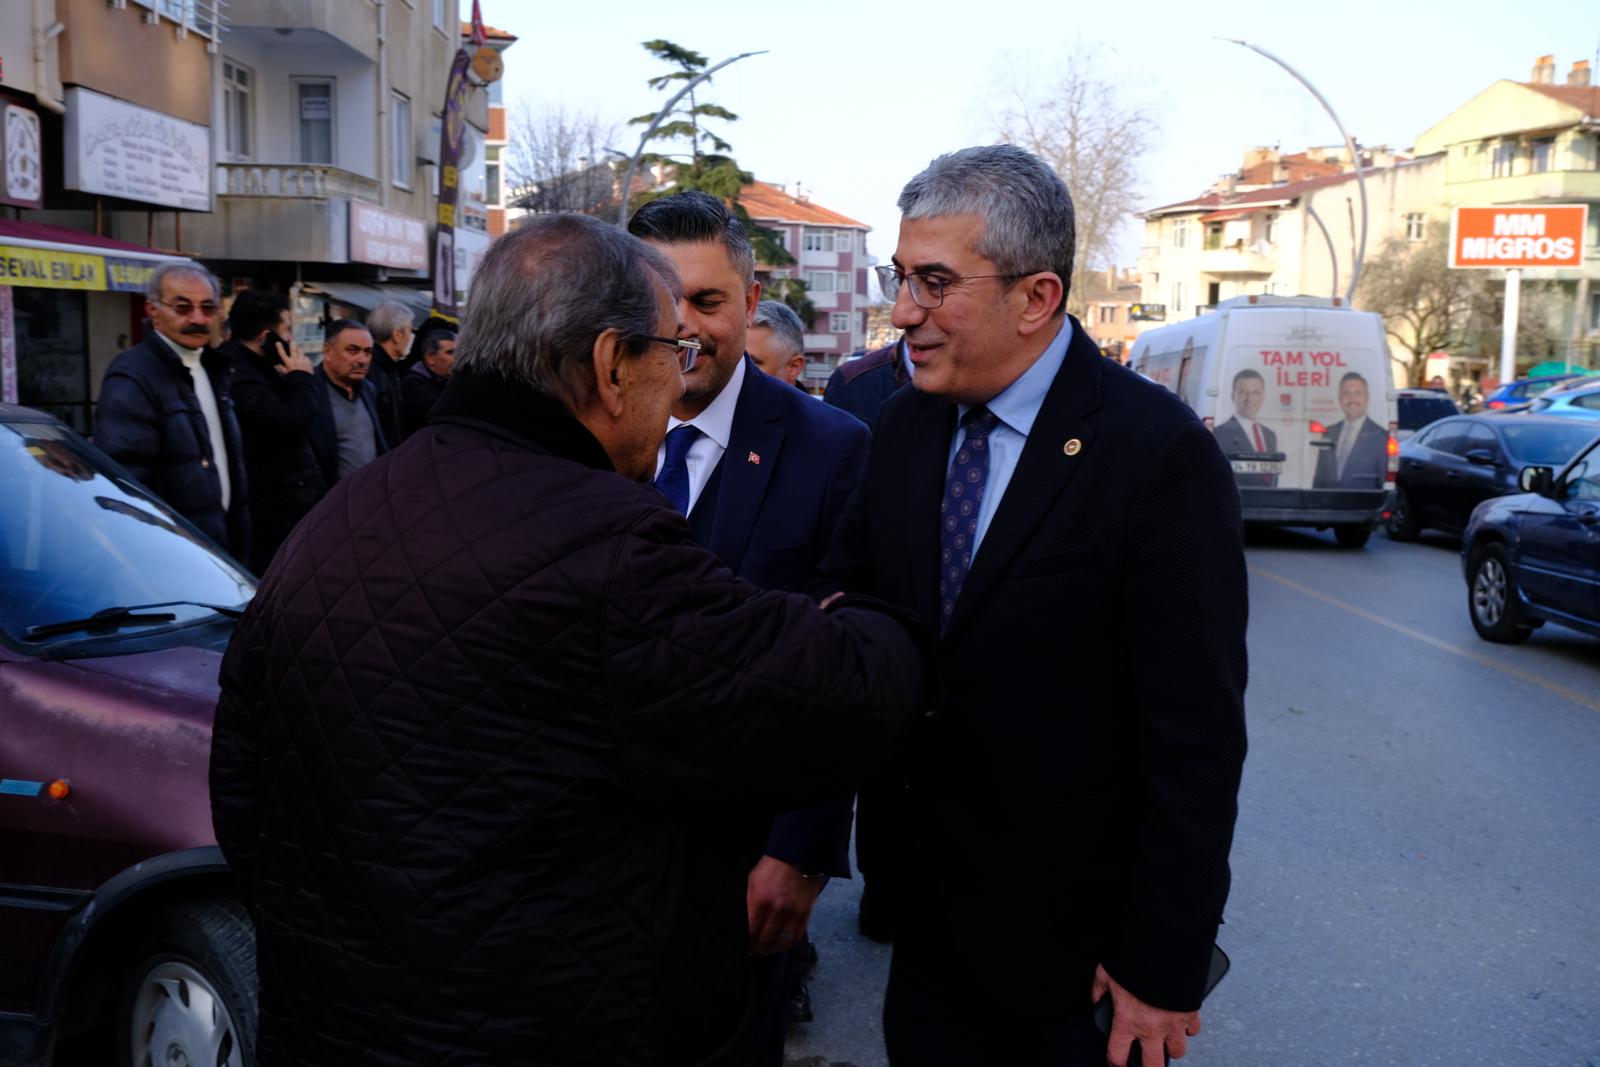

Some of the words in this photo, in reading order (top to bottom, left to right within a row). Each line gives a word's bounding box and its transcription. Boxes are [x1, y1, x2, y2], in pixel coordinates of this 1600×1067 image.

[1493, 213, 1546, 236] MM
[1259, 351, 1303, 366] TAM
[1309, 352, 1347, 367] YOL
[1276, 367, 1331, 387] İLERİ
